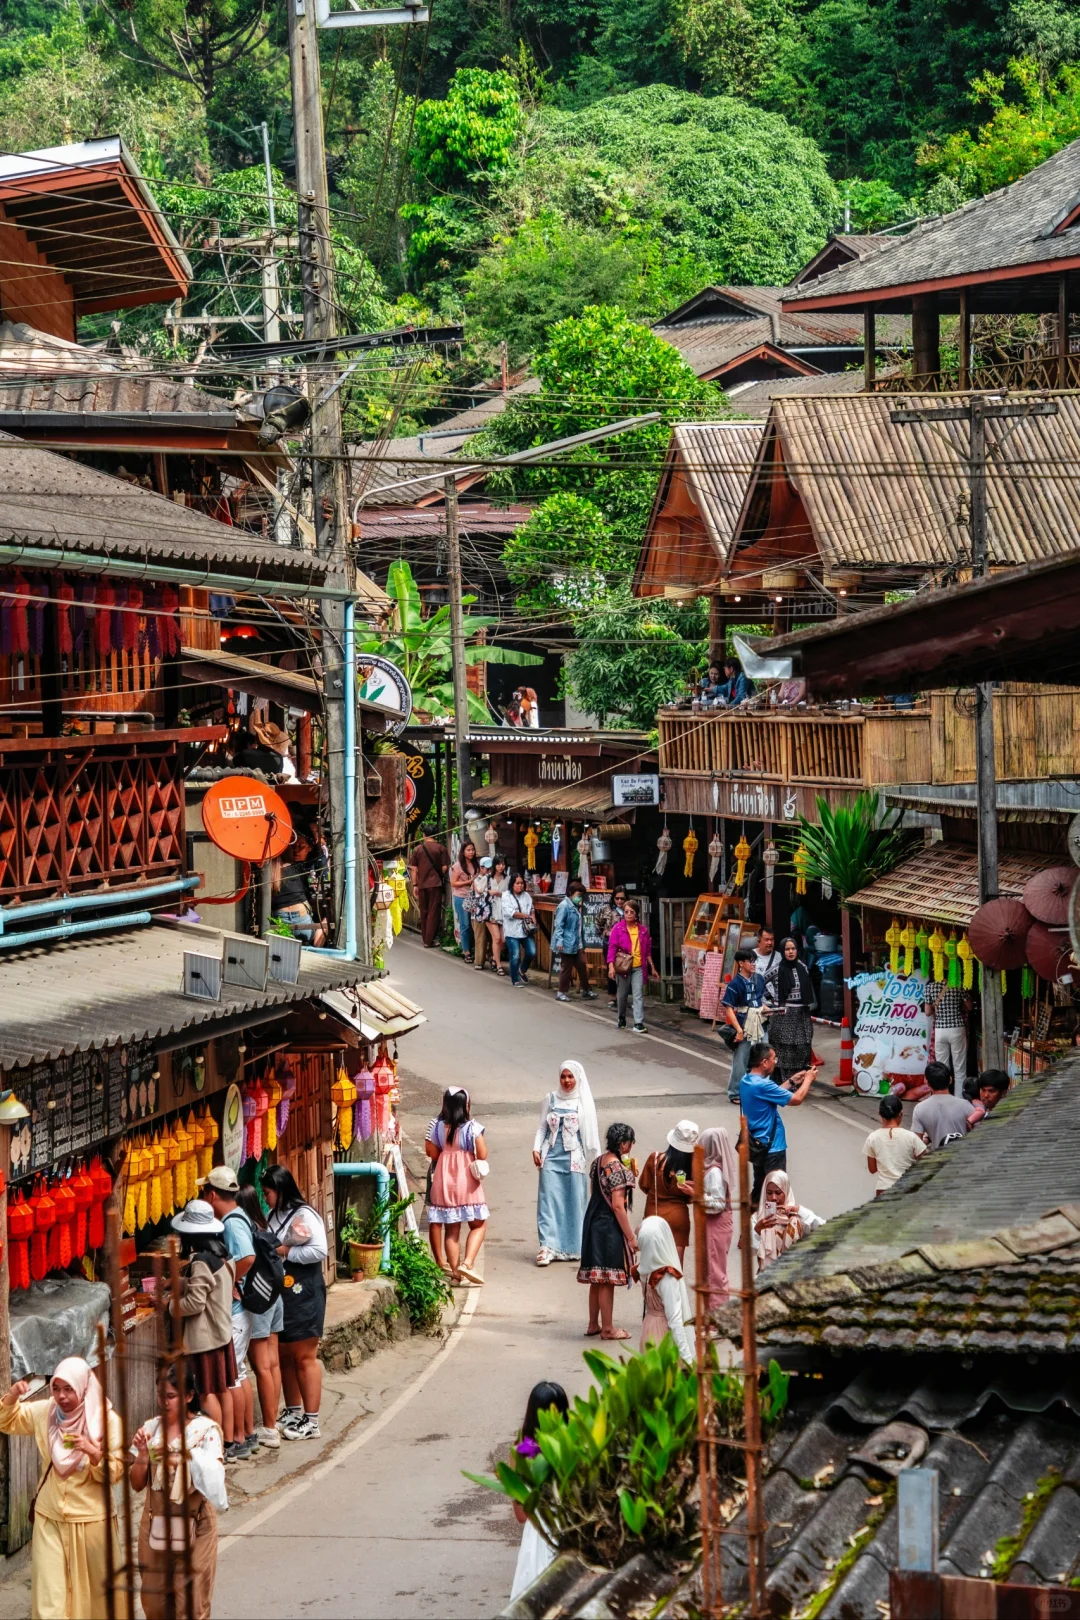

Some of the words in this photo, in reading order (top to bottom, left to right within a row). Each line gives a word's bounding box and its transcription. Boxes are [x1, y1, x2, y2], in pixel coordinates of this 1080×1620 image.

[222, 798, 263, 811] IPM
[883, 971, 925, 998] ไอติม
[860, 998, 918, 1019] กะทิสด
[856, 1021, 922, 1037] มะพร้าวอ่อน
